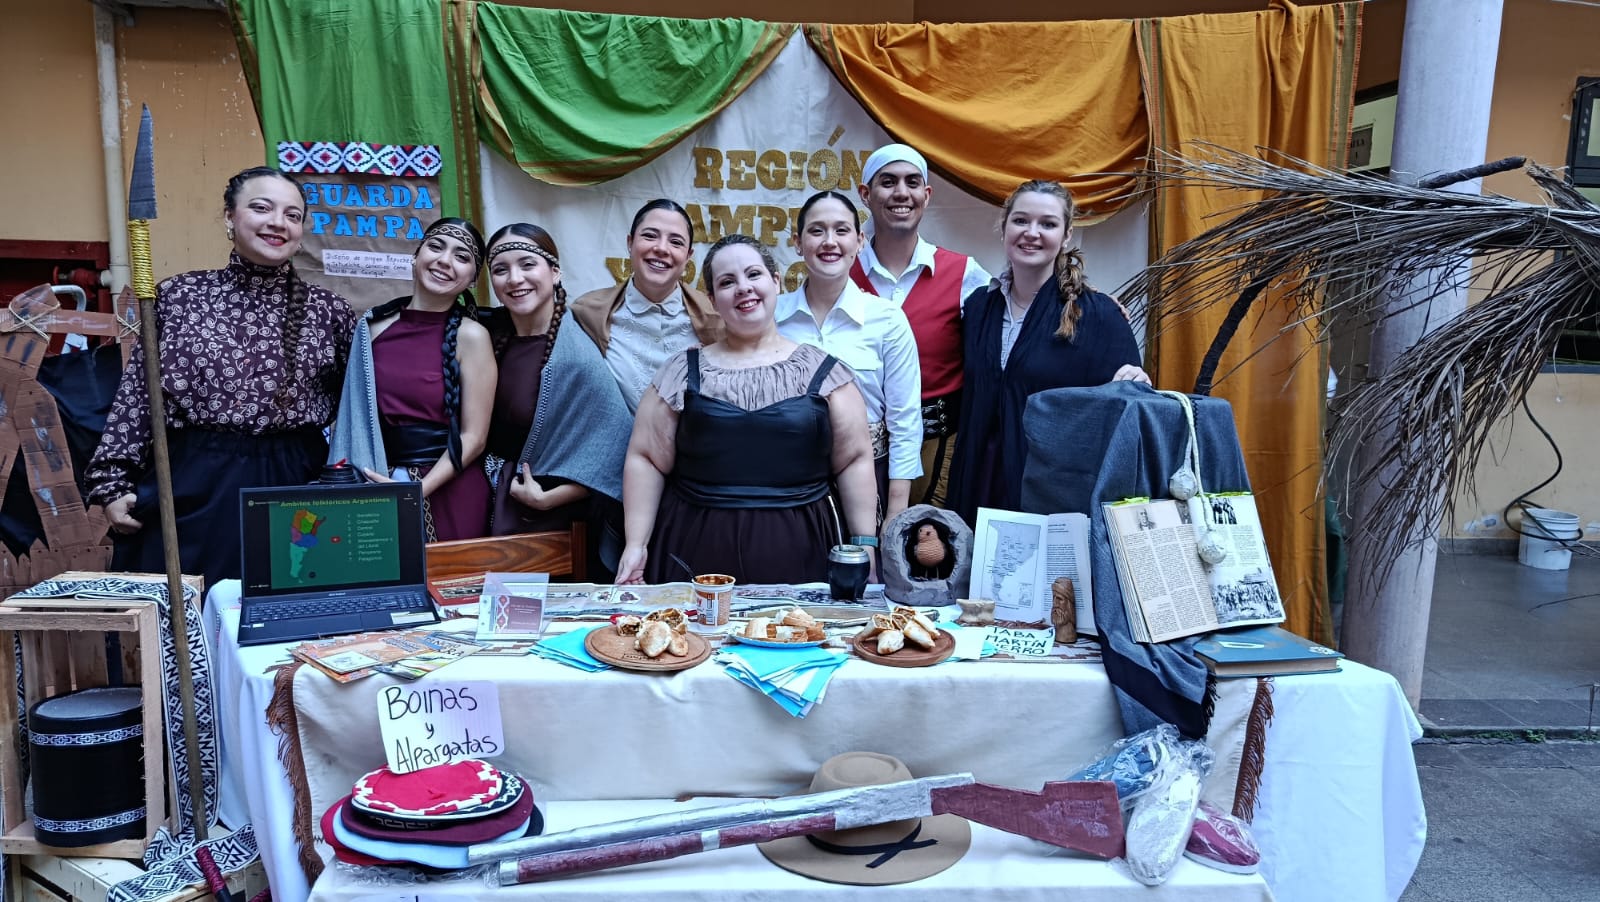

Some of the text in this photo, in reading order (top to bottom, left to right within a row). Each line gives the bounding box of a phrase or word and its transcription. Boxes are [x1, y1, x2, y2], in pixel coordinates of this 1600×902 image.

[693, 124, 874, 191] REGIÓN
[302, 182, 434, 209] GUARDA
[311, 211, 425, 239] PAMPA
[985, 635, 1047, 648] MARTÍN
[993, 627, 1035, 639] TABA
[425, 722, 434, 739] y
[395, 728, 498, 772] Alpargatas
